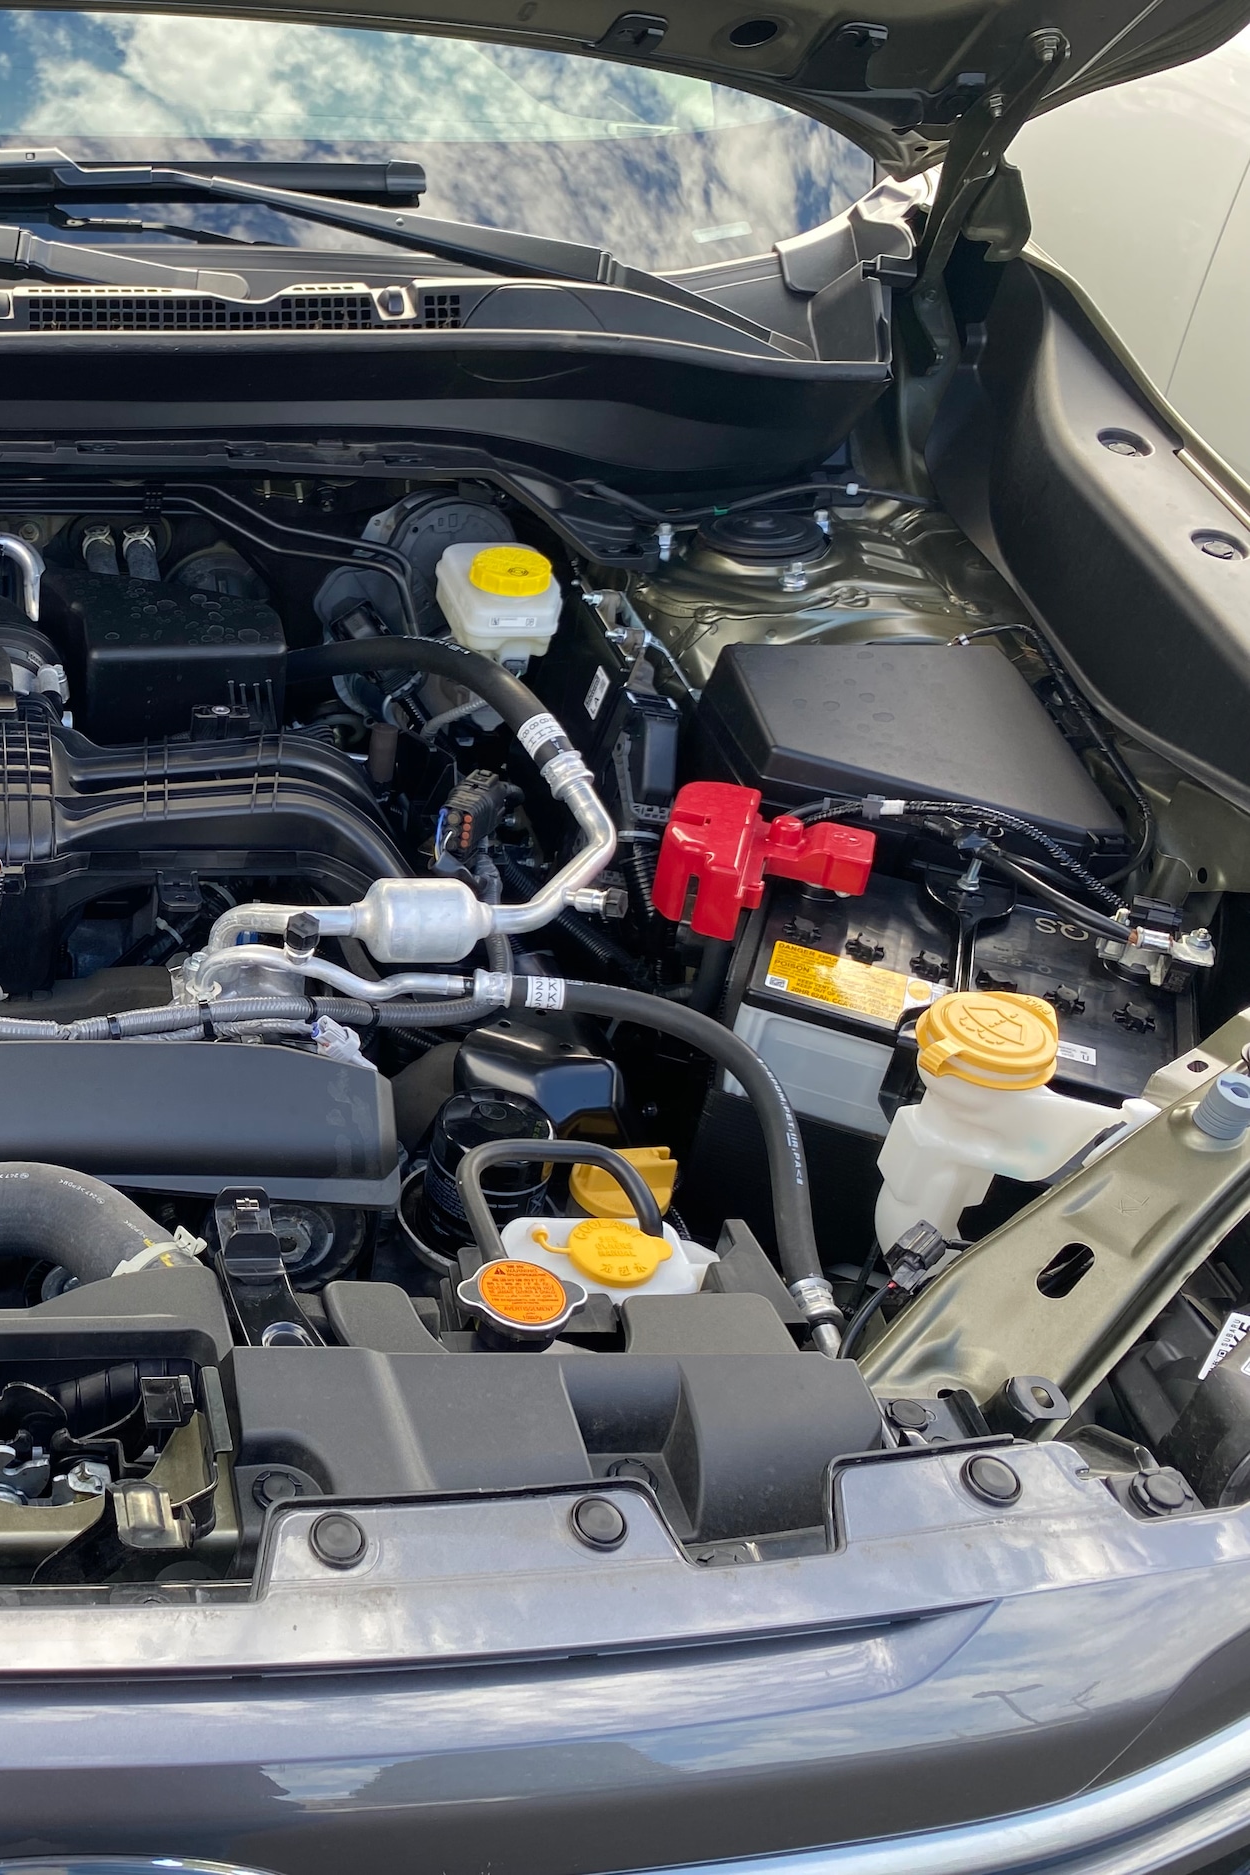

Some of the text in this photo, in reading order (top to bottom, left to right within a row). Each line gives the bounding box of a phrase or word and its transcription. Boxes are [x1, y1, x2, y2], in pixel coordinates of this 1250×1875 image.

[778, 943, 816, 956] DANGER
[774, 960, 810, 973] POISON
[549, 982, 558, 992] K
[548, 992, 557, 1002] K
[573, 1218, 643, 1240] COOLANT
[1221, 1318, 1241, 1347] SUBARU
